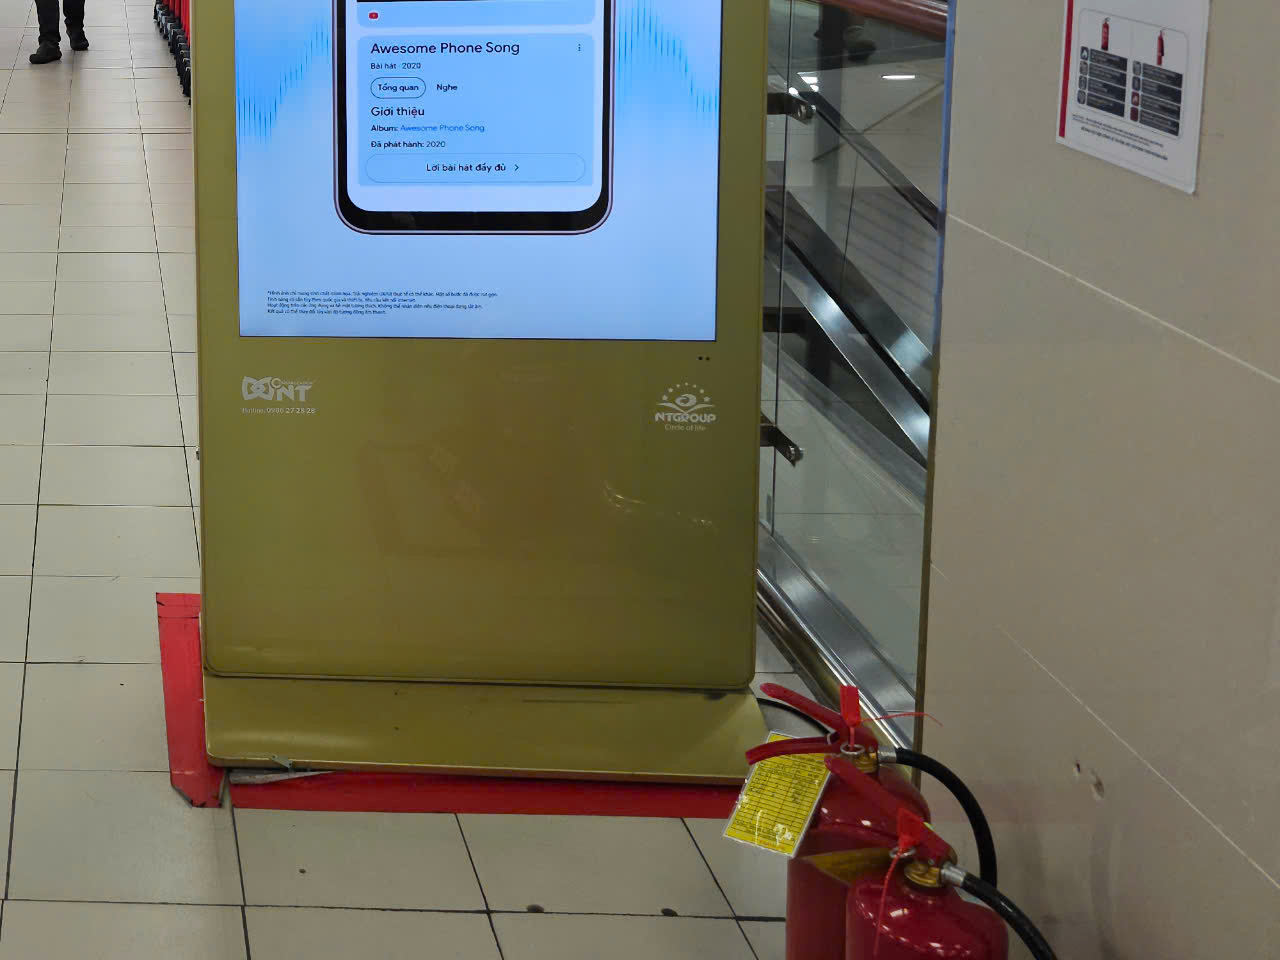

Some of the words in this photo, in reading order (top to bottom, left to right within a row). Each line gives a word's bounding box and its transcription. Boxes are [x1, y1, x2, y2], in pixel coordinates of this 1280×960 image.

[370, 43, 437, 54] Awesome
[440, 42, 483, 54] Phone
[485, 41, 521, 56] Song
[370, 62, 383, 70] Bài
[384, 62, 397, 70] hát
[402, 62, 422, 70] 2020
[399, 84, 419, 92] quan
[436, 83, 458, 93] Nghe
[370, 106, 394, 117] Giới
[396, 106, 425, 119] thiệu
[370, 124, 399, 132] Album:
[400, 124, 438, 132] Awesome
[439, 124, 464, 132] Phone
[465, 123, 485, 133] Song
[370, 140, 382, 148] Đã
[383, 140, 402, 149] phát
[426, 140, 446, 148] 2020
[426, 163, 440, 172] Lời
[442, 163, 456, 172] bài
[458, 163, 473, 172] hát
[494, 162, 507, 172] đủ
[654, 412, 717, 423] NTGROUP
